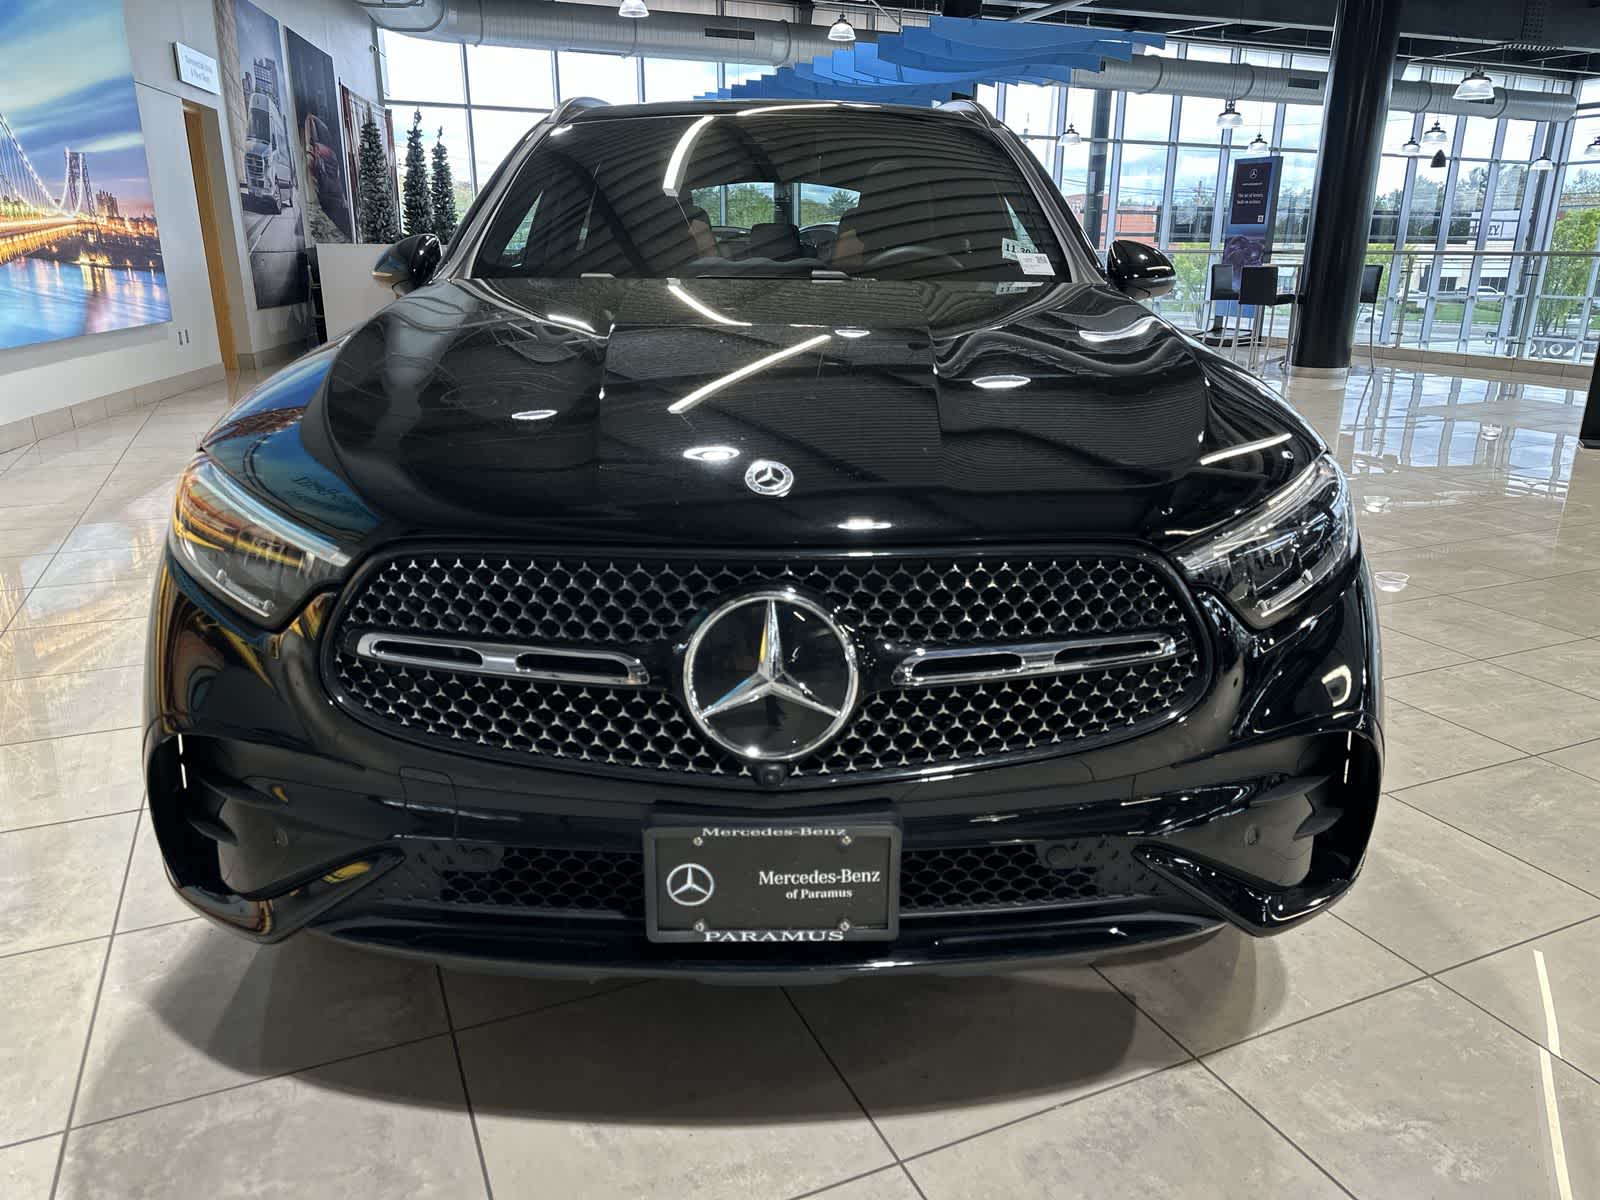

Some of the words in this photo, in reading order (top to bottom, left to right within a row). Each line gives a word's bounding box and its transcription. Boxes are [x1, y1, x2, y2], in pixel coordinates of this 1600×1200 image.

[702, 827, 846, 837] Mercedes-Benz
[759, 869, 880, 885] Mercedes-Benz
[786, 889, 798, 899] of
[800, 888, 852, 899] Paramus
[704, 930, 844, 942] PARAMUS
